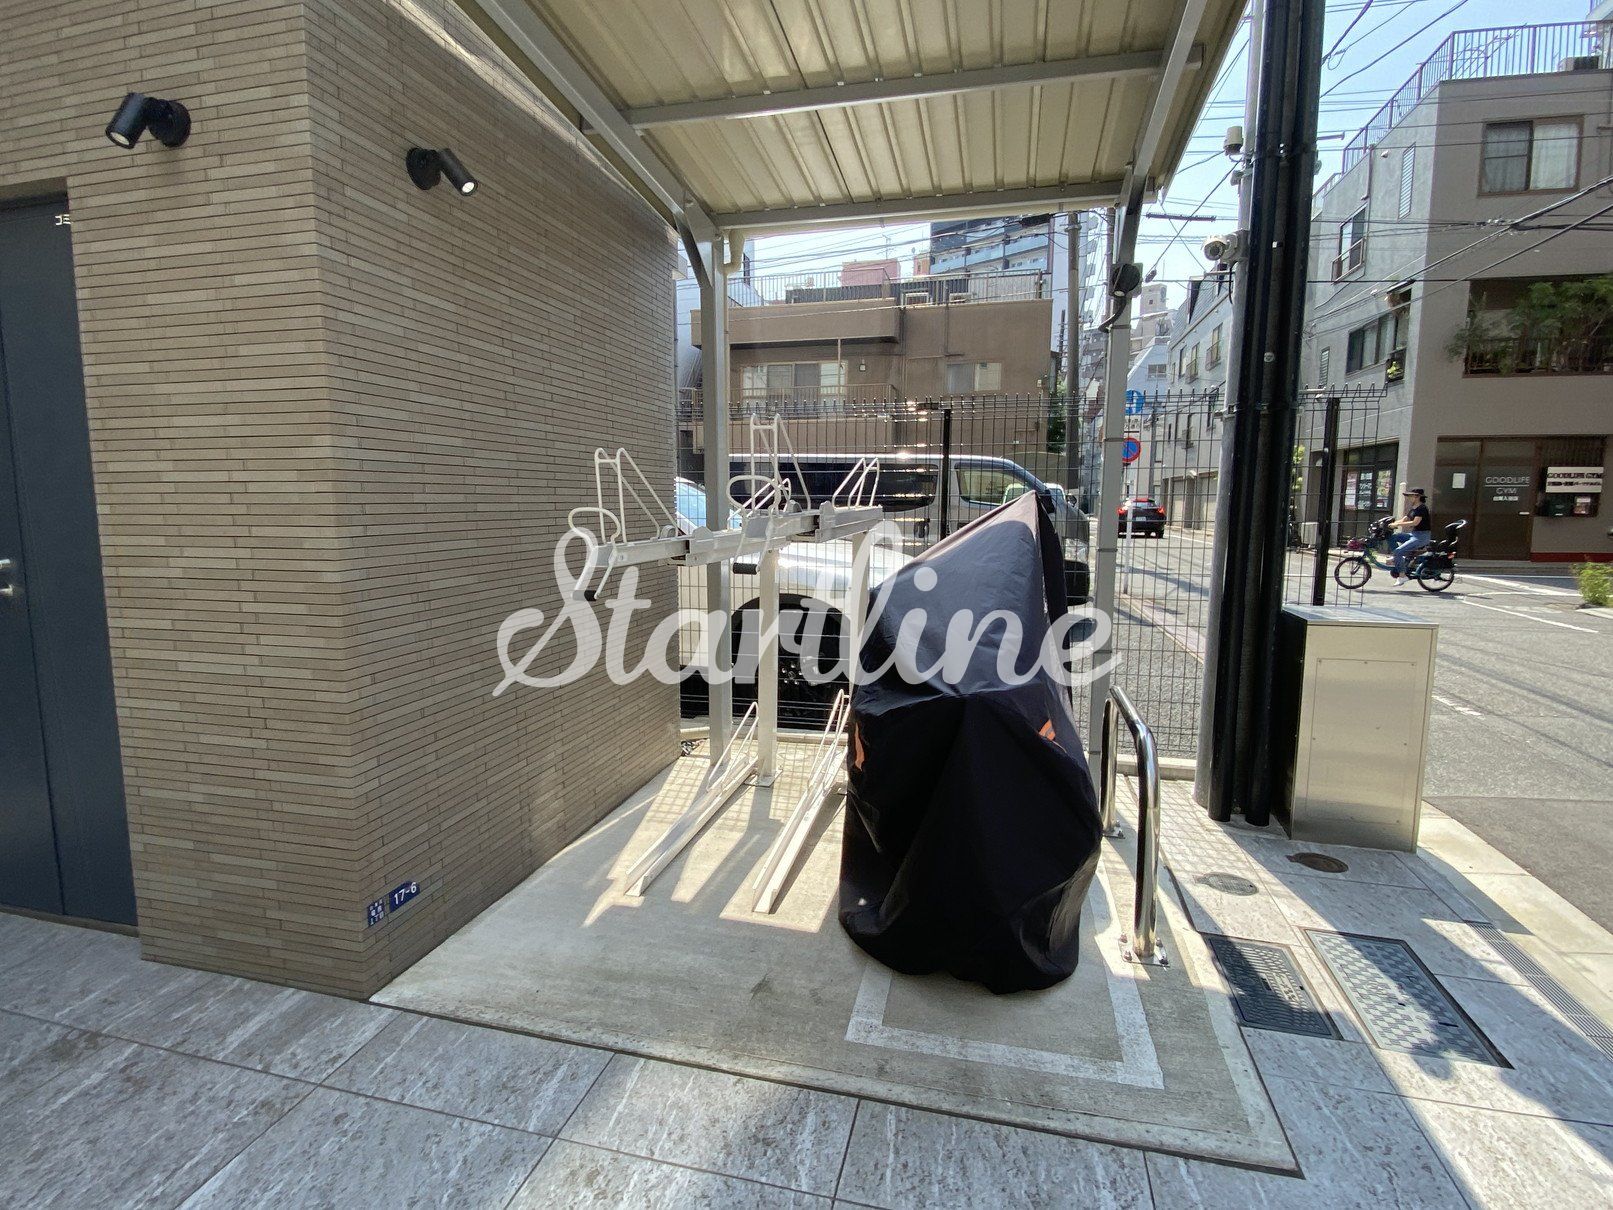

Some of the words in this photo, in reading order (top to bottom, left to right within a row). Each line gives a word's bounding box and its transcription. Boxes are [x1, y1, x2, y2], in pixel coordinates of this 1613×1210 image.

[1485, 476, 1531, 484] GOODLIFE
[1495, 487, 1517, 495] GYM
[393, 881, 417, 905] 17-6
